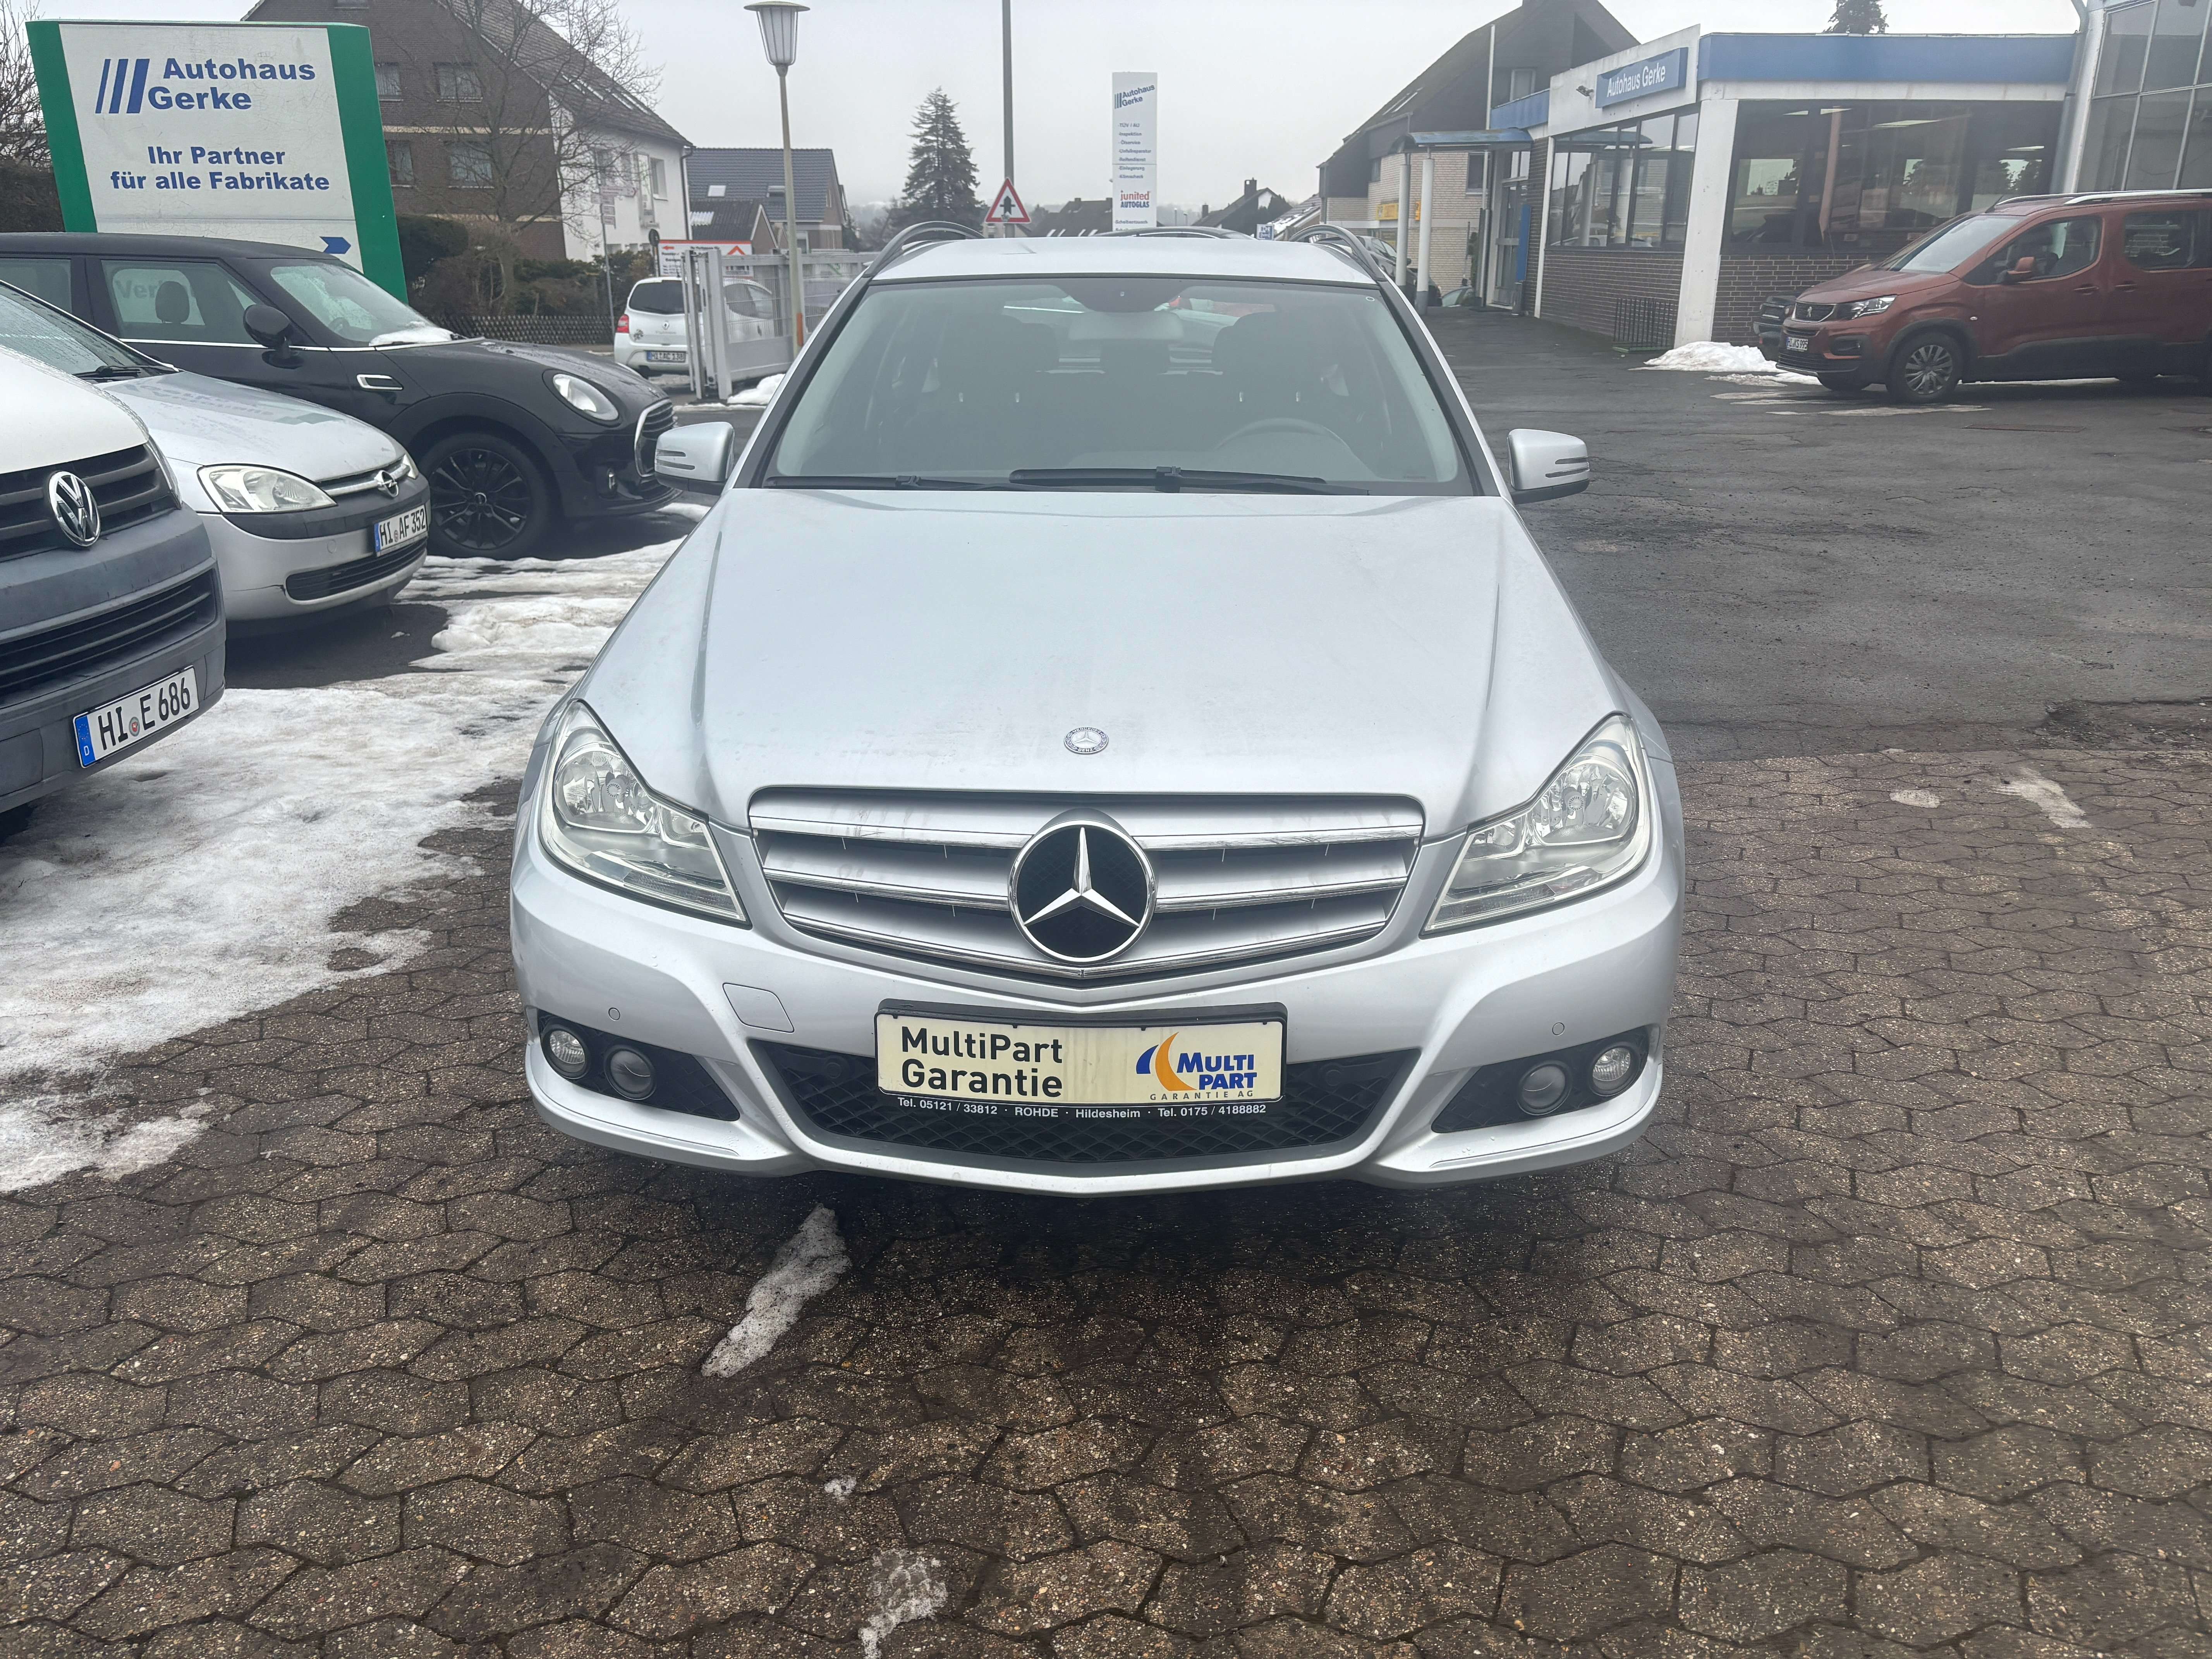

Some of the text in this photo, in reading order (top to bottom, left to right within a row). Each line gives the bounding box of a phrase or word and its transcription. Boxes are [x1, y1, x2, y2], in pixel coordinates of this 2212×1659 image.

[163, 58, 316, 80] Autohaus
[1607, 62, 1666, 98] Autohaus Gerke
[148, 86, 252, 110] Gerke
[1122, 96, 1143, 106] Gerke
[1123, 85, 1155, 98] Autohaus
[148, 146, 285, 165] Ihr Partner
[110, 171, 330, 190] für alle Fabrikate
[1120, 190, 1150, 201] junited
[379, 508, 426, 546] HI AF 352
[98, 677, 191, 750] HI E 686
[84, 745, 90, 756] D
[902, 1026, 1063, 1063] MultiPart
[1176, 1052, 1254, 1073] MULTI
[902, 1058, 1063, 1097] Garantie
[1199, 1072, 1257, 1090] PART
[1150, 1091, 1228, 1100] GARANTIE
[897, 1097, 916, 1108] Tel.
[920, 1099, 952, 1111] 05121
[963, 1104, 998, 1115] 33812
[1015, 1107, 1059, 1117] ROHDE
[1076, 1109, 1141, 1118] Hildesheim
[1158, 1108, 1177, 1117] Tel.
[1181, 1107, 1208, 1117] 0175
[1218, 1104, 1266, 1115] 4188882
